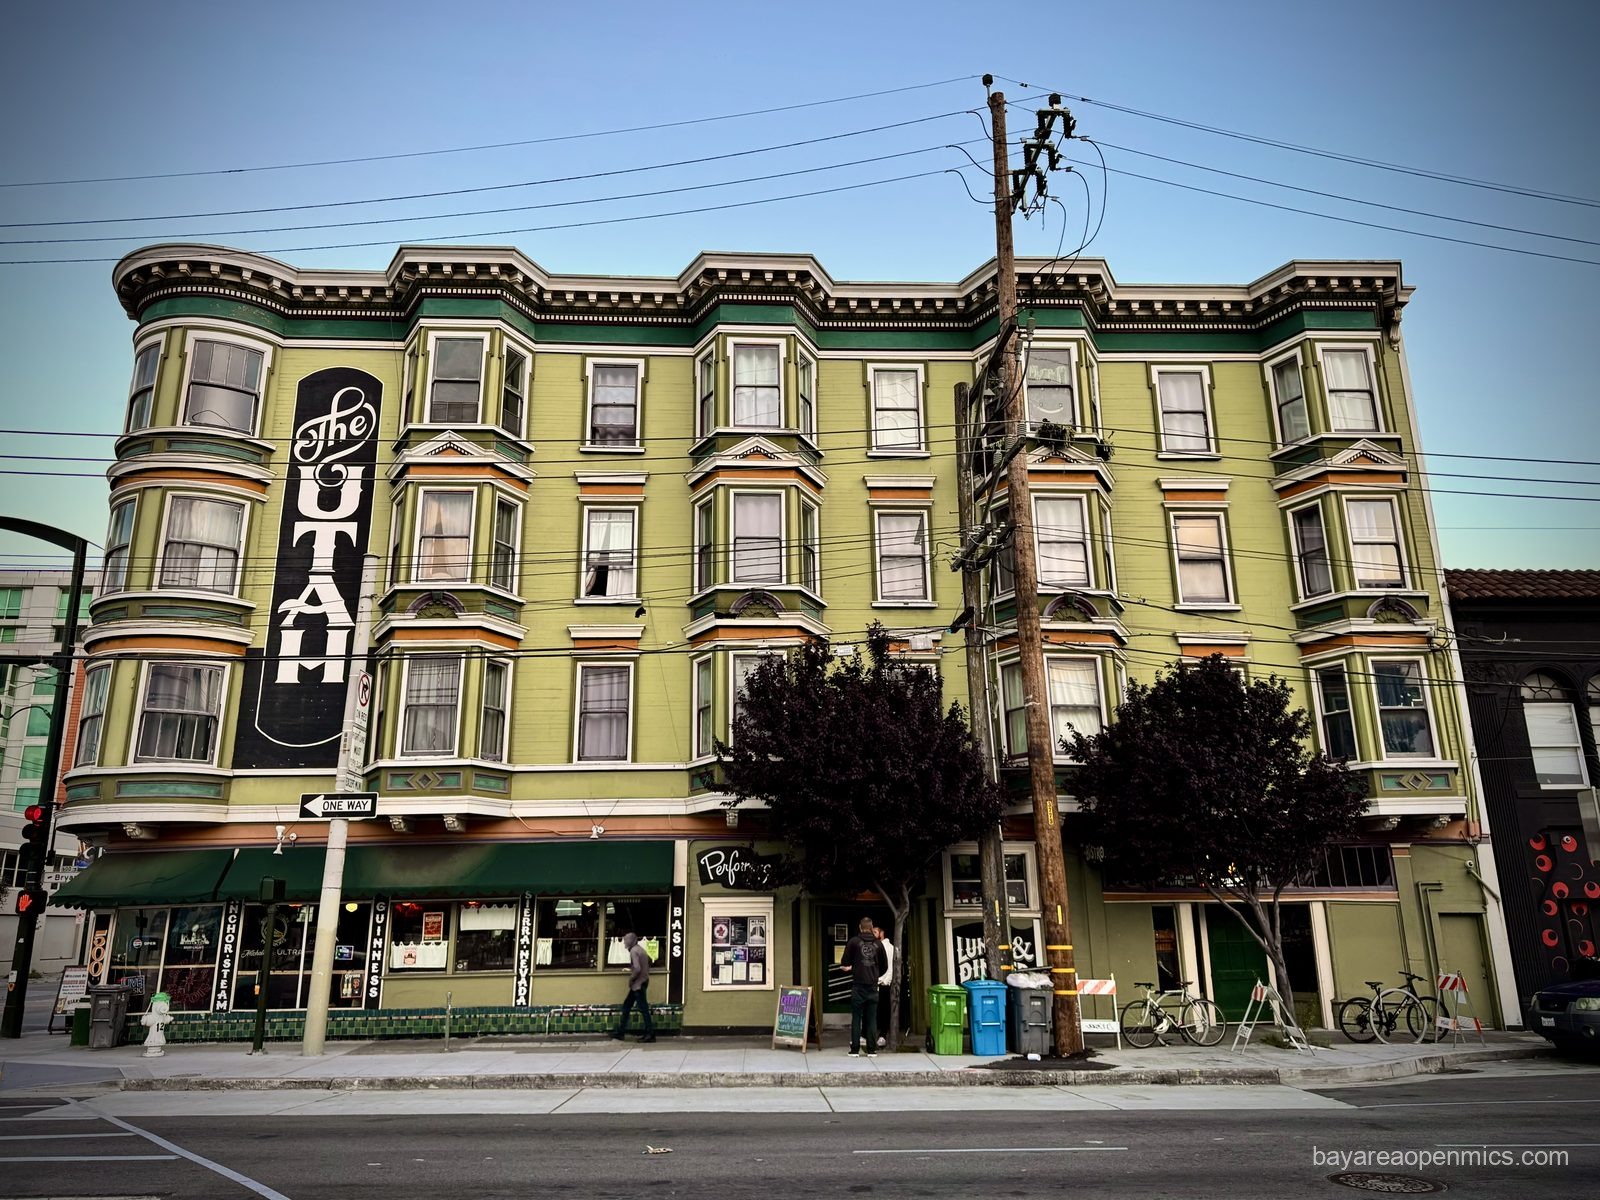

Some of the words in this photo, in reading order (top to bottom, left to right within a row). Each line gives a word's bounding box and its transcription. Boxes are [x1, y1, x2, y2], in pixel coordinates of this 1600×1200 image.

[295, 387, 377, 480] The
[275, 465, 365, 685] UTAH
[322, 800, 344, 811] ONE
[347, 800, 369, 811] WAY
[54, 873, 76, 883] Brya
[223, 899, 239, 954] NCHOR
[520, 890, 533, 945] SIERRA
[671, 906, 682, 958] BASS
[89, 929, 108, 977] 500
[276, 948, 302, 956] ULTRA
[368, 901, 387, 998] GUINNESS
[956, 935, 987, 964] LUN
[1012, 936, 1035, 962] &
[516, 949, 530, 1006] NEVADA
[155, 1022, 165, 1033] 12
